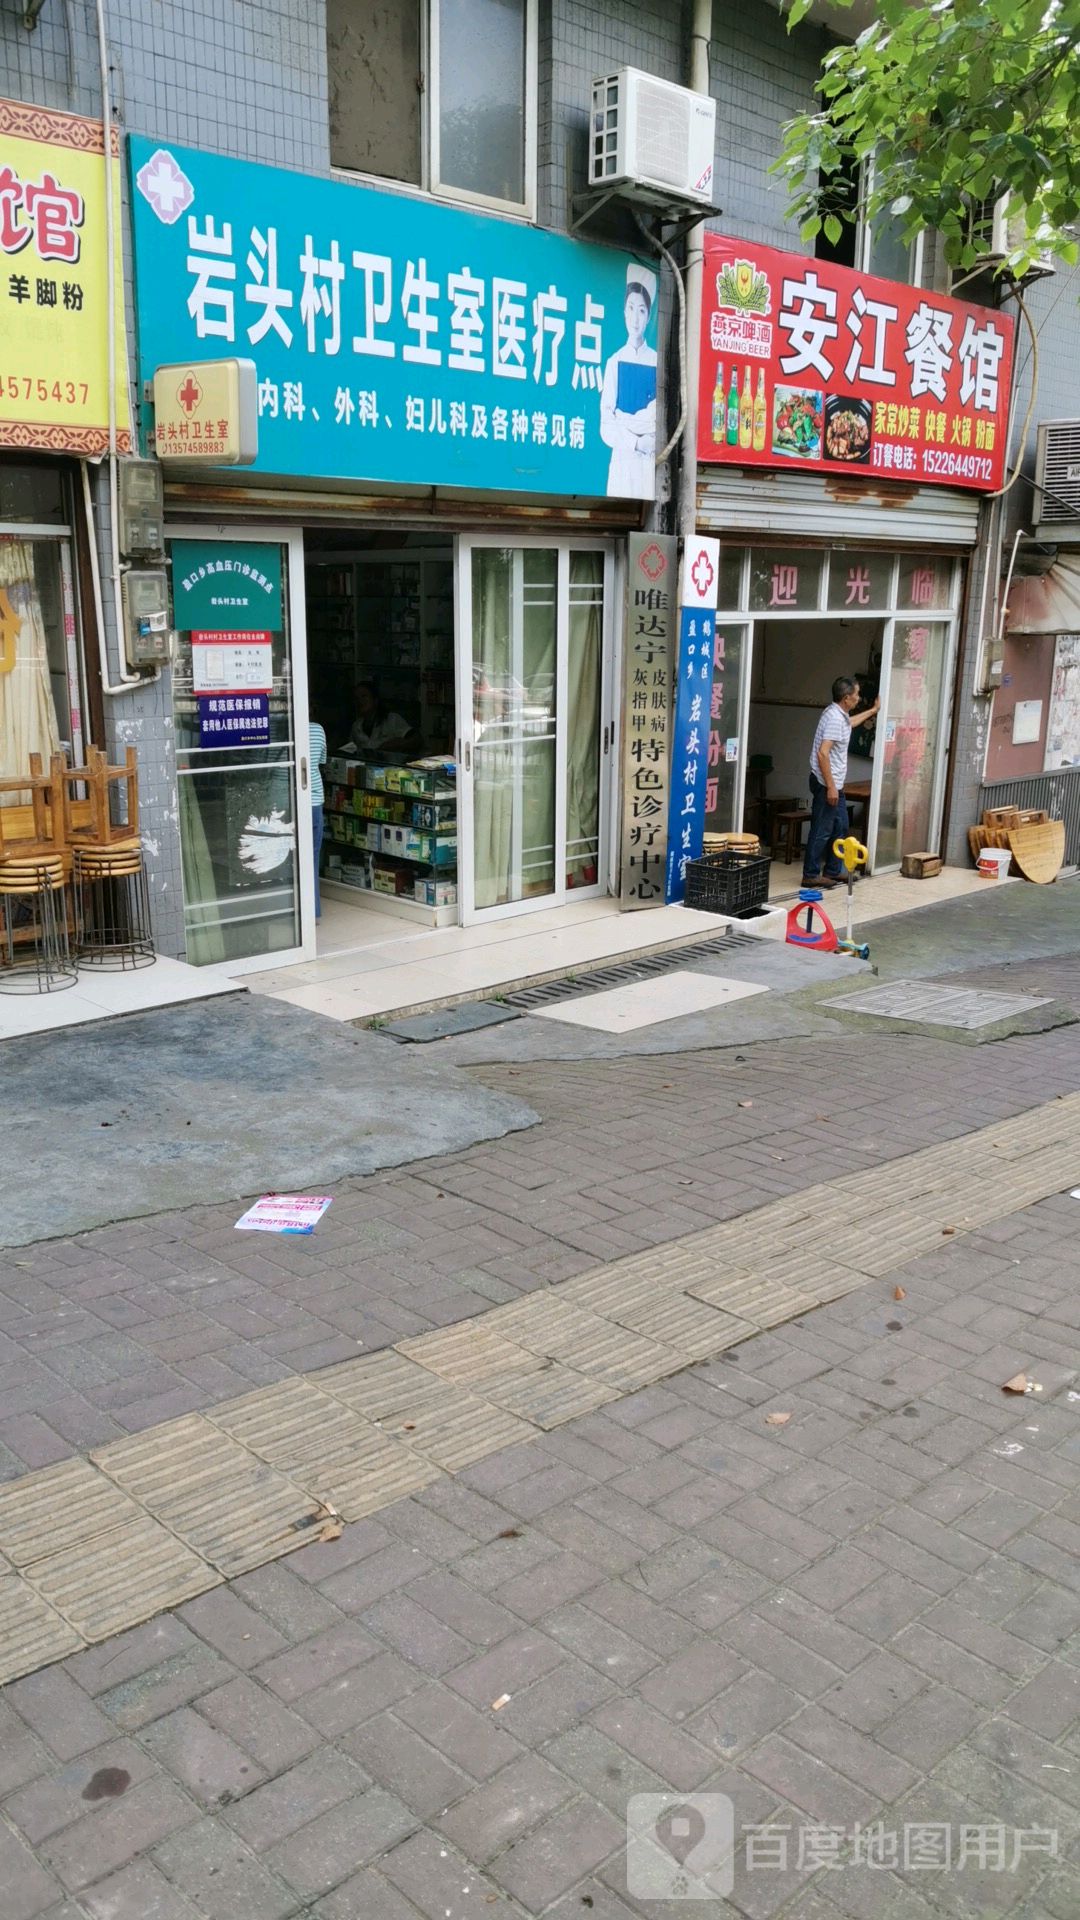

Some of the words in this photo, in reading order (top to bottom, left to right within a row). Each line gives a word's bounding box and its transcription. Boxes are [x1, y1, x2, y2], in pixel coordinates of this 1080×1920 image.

[8, 273, 84, 311] 羊脚粉
[186, 214, 605, 392] 岩头村卫生室医疗点
[712, 314, 771, 343] 燕京啤酒
[712, 337, 747, 353] YANJING
[748, 343, 770, 357] BEER
[778, 271, 1004, 413] 安江餐馆
[157, 419, 229, 441] 岩头村卫生室
[874, 401, 921, 439] 家常炒菜
[925, 409, 947, 443] 快餐
[951, 414, 971, 448] 火锅
[975, 418, 996, 450] 粉面
[922, 449, 993, 480] 15226449712
[634, 588, 669, 664] 唯达宁
[701, 618, 711, 679] 鹤城区
[208, 698, 261, 712] 规范医保报销
[632, 668, 648, 732] 灰指甲
[650, 669, 667, 733] 皮肤病
[629, 738, 665, 900] 特色诊疗中心
